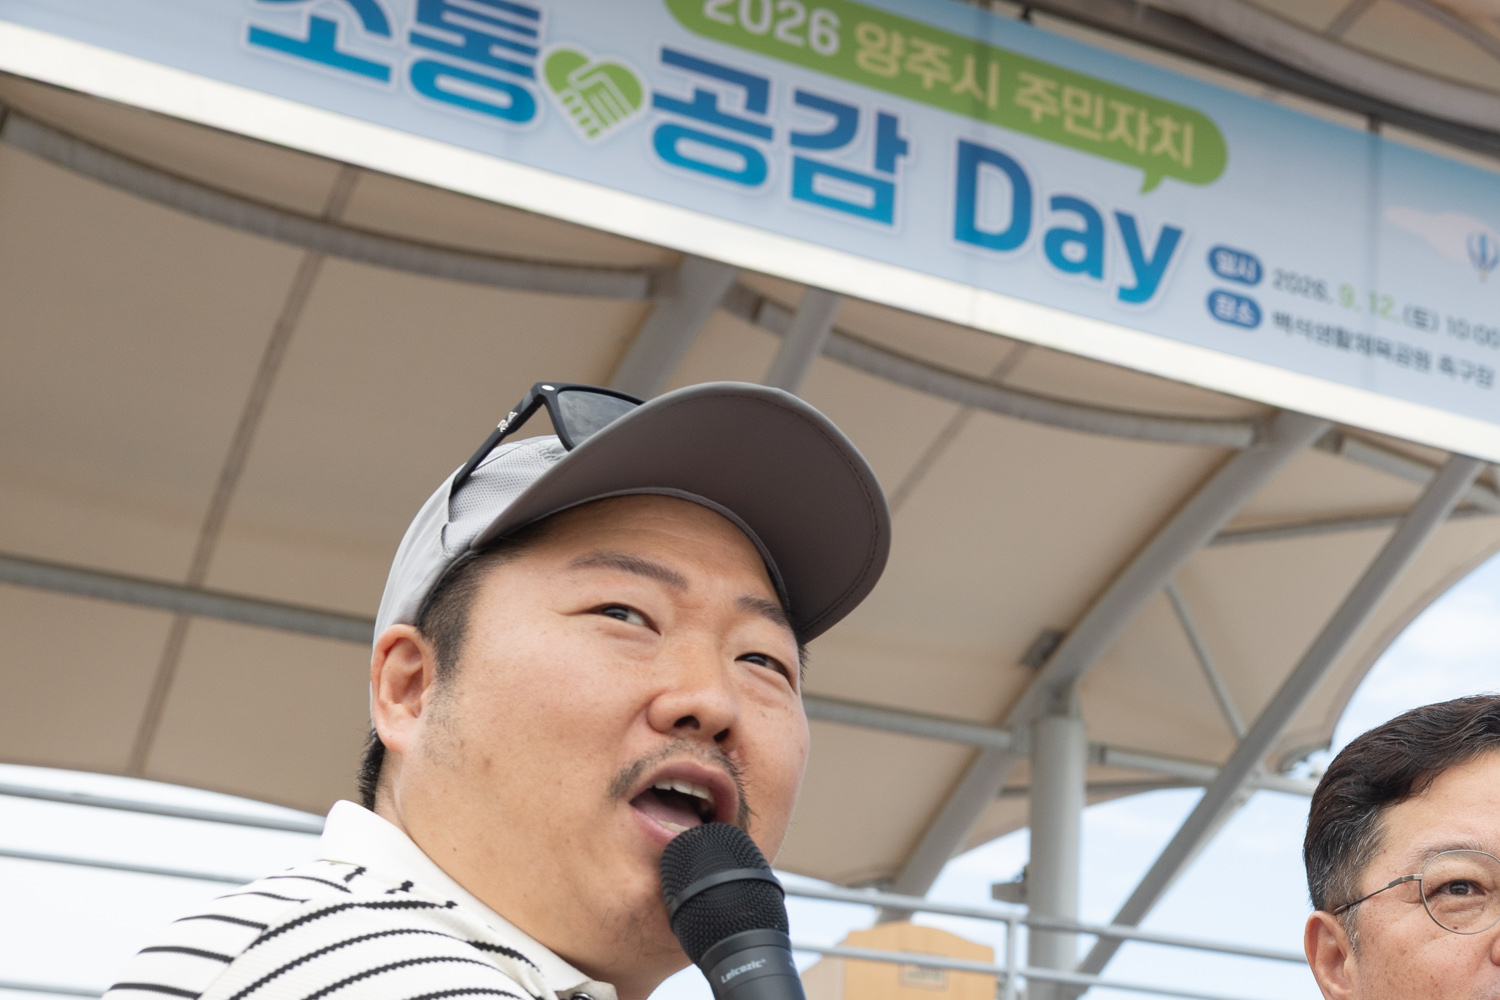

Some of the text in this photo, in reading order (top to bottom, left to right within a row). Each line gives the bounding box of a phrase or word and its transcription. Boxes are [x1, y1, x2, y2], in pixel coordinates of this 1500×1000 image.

[247, 0, 1184, 305] 소통 공감 Day
[854, 22, 999, 110] 양주시
[1014, 71, 1194, 169] 주민자치
